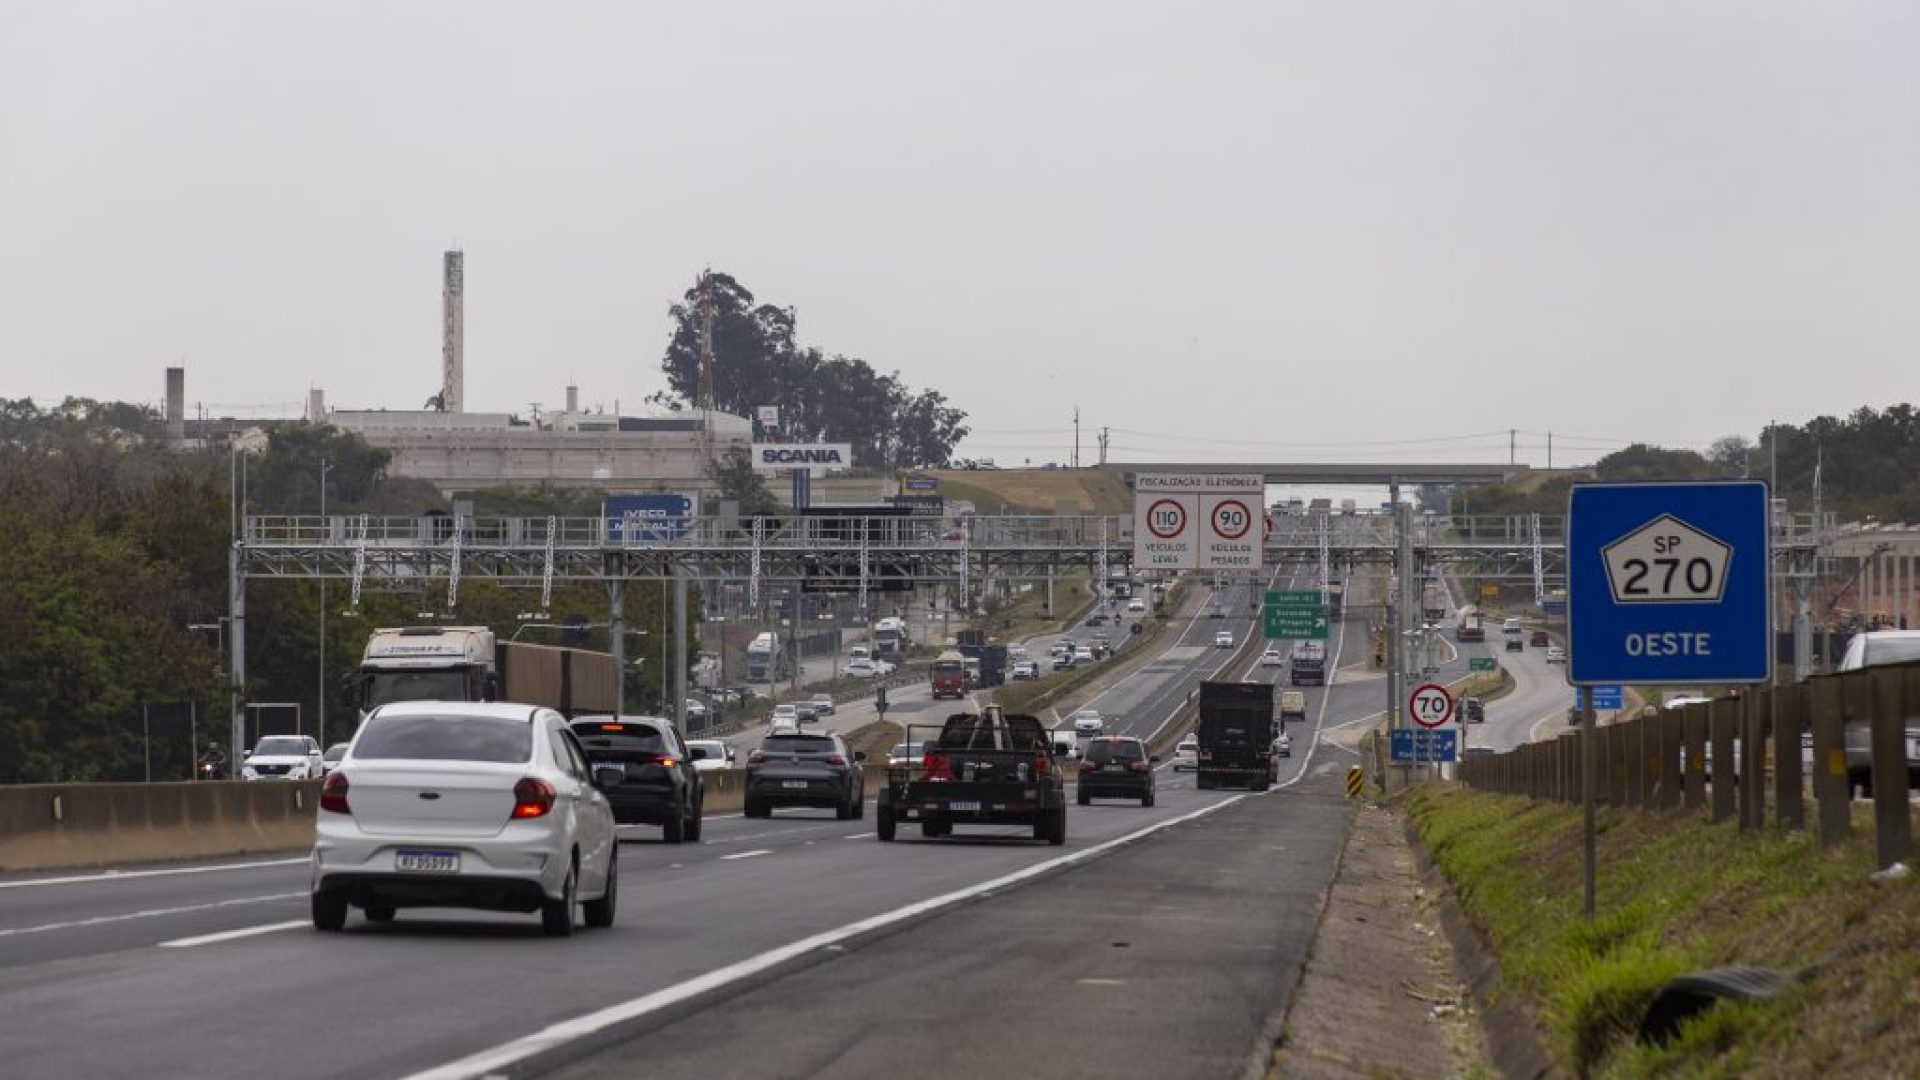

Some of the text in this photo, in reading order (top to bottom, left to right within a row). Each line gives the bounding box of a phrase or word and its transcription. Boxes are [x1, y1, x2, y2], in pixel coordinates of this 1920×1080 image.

[762, 449, 842, 463] SCANIA
[1156, 511, 1178, 526] 110
[1220, 511, 1242, 526] 90
[1653, 535, 1681, 554] SP
[1622, 556, 1713, 595] 270
[1624, 632, 1711, 656] OESTE
[1417, 697, 1445, 713] 70
